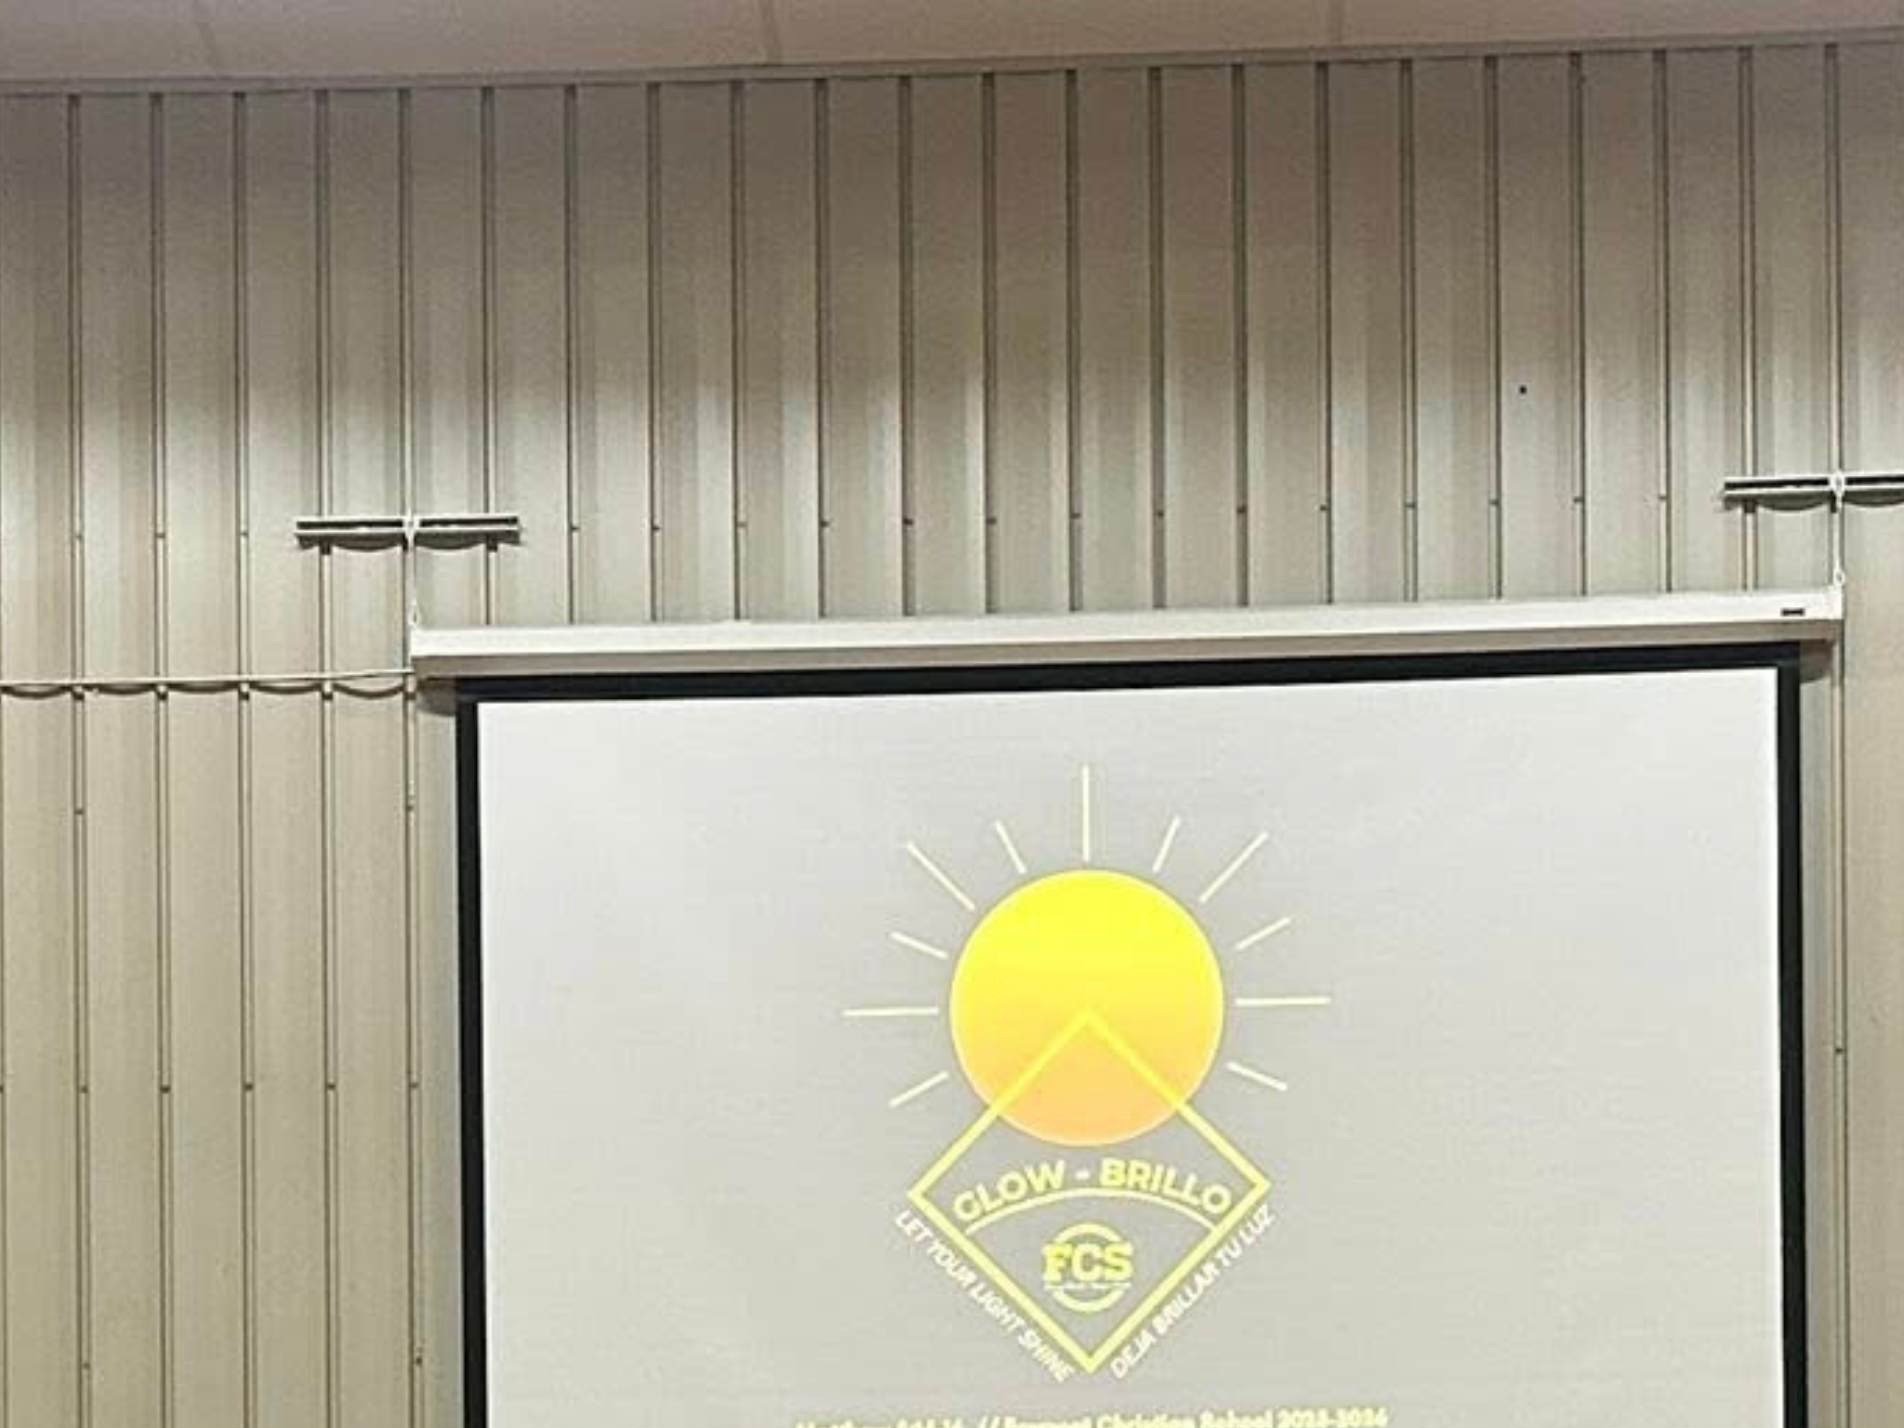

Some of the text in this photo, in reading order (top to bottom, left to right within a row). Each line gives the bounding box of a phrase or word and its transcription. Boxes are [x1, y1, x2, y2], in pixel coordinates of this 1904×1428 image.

[953, 1160, 1065, 1221] GLOW
[1099, 1157, 1232, 1215] BRILLO
[1042, 1241, 1135, 1282] FCS
